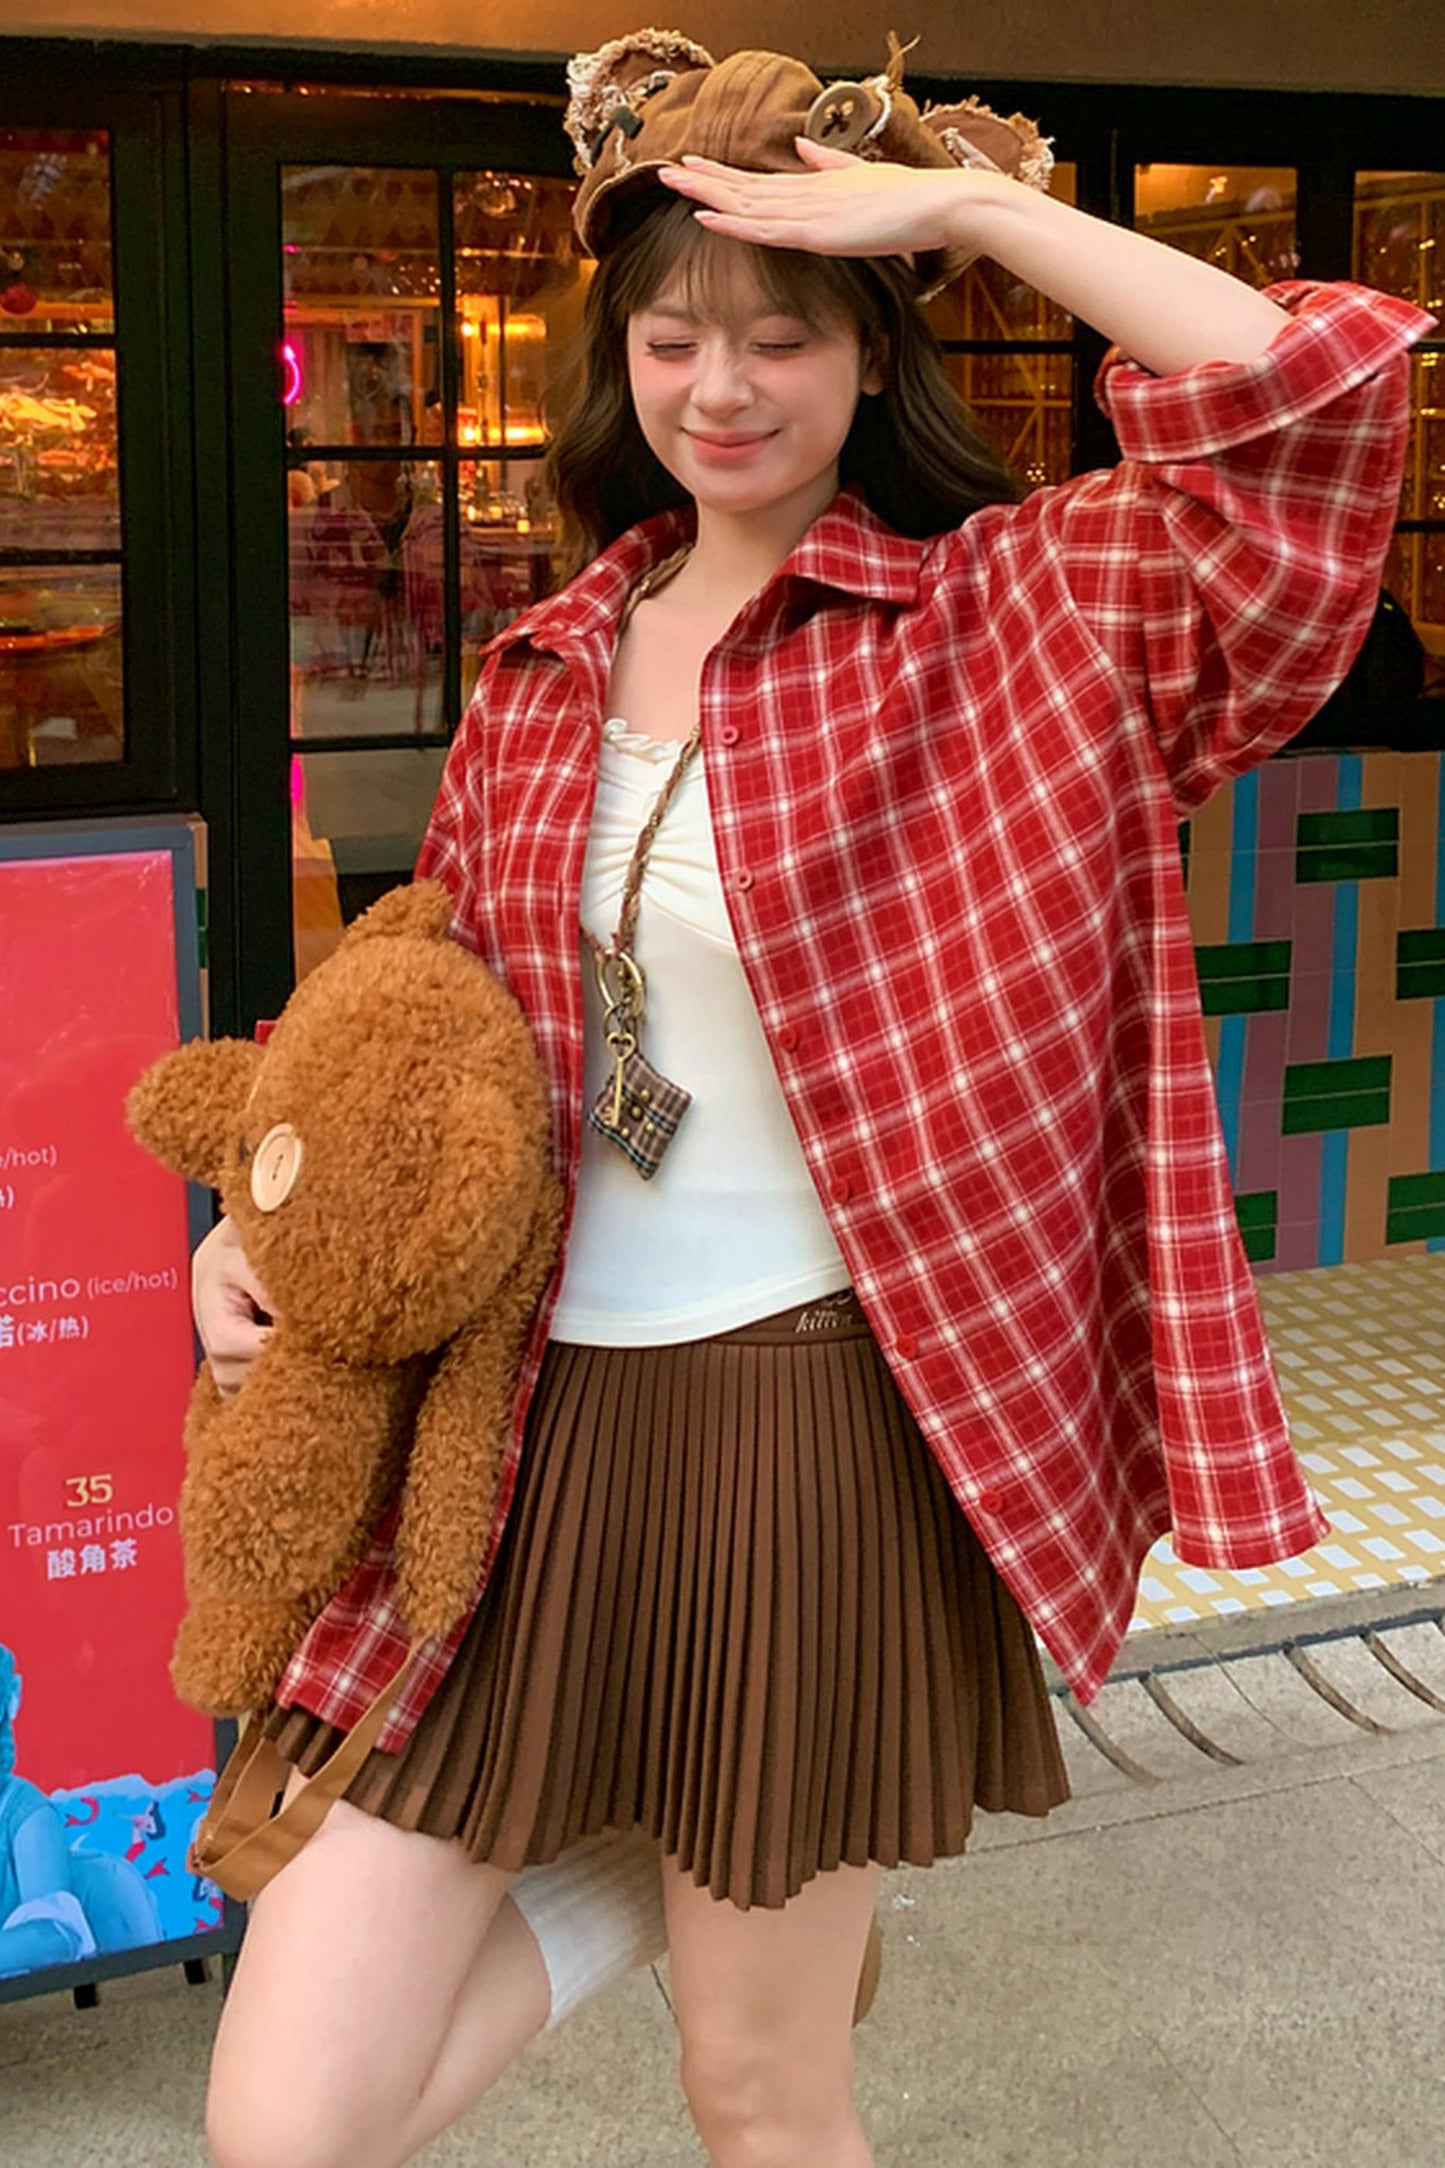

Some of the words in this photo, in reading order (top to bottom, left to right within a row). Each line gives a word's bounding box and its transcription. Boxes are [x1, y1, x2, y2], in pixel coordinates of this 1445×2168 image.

[0, 1144, 57, 1170] /hot)
[87, 1267, 178, 1299] (ice/hot)
[66, 1473, 113, 1507] 35
[8, 1503, 174, 1548] Tamarindo
[47, 1538, 137, 1580] 酸角茶
